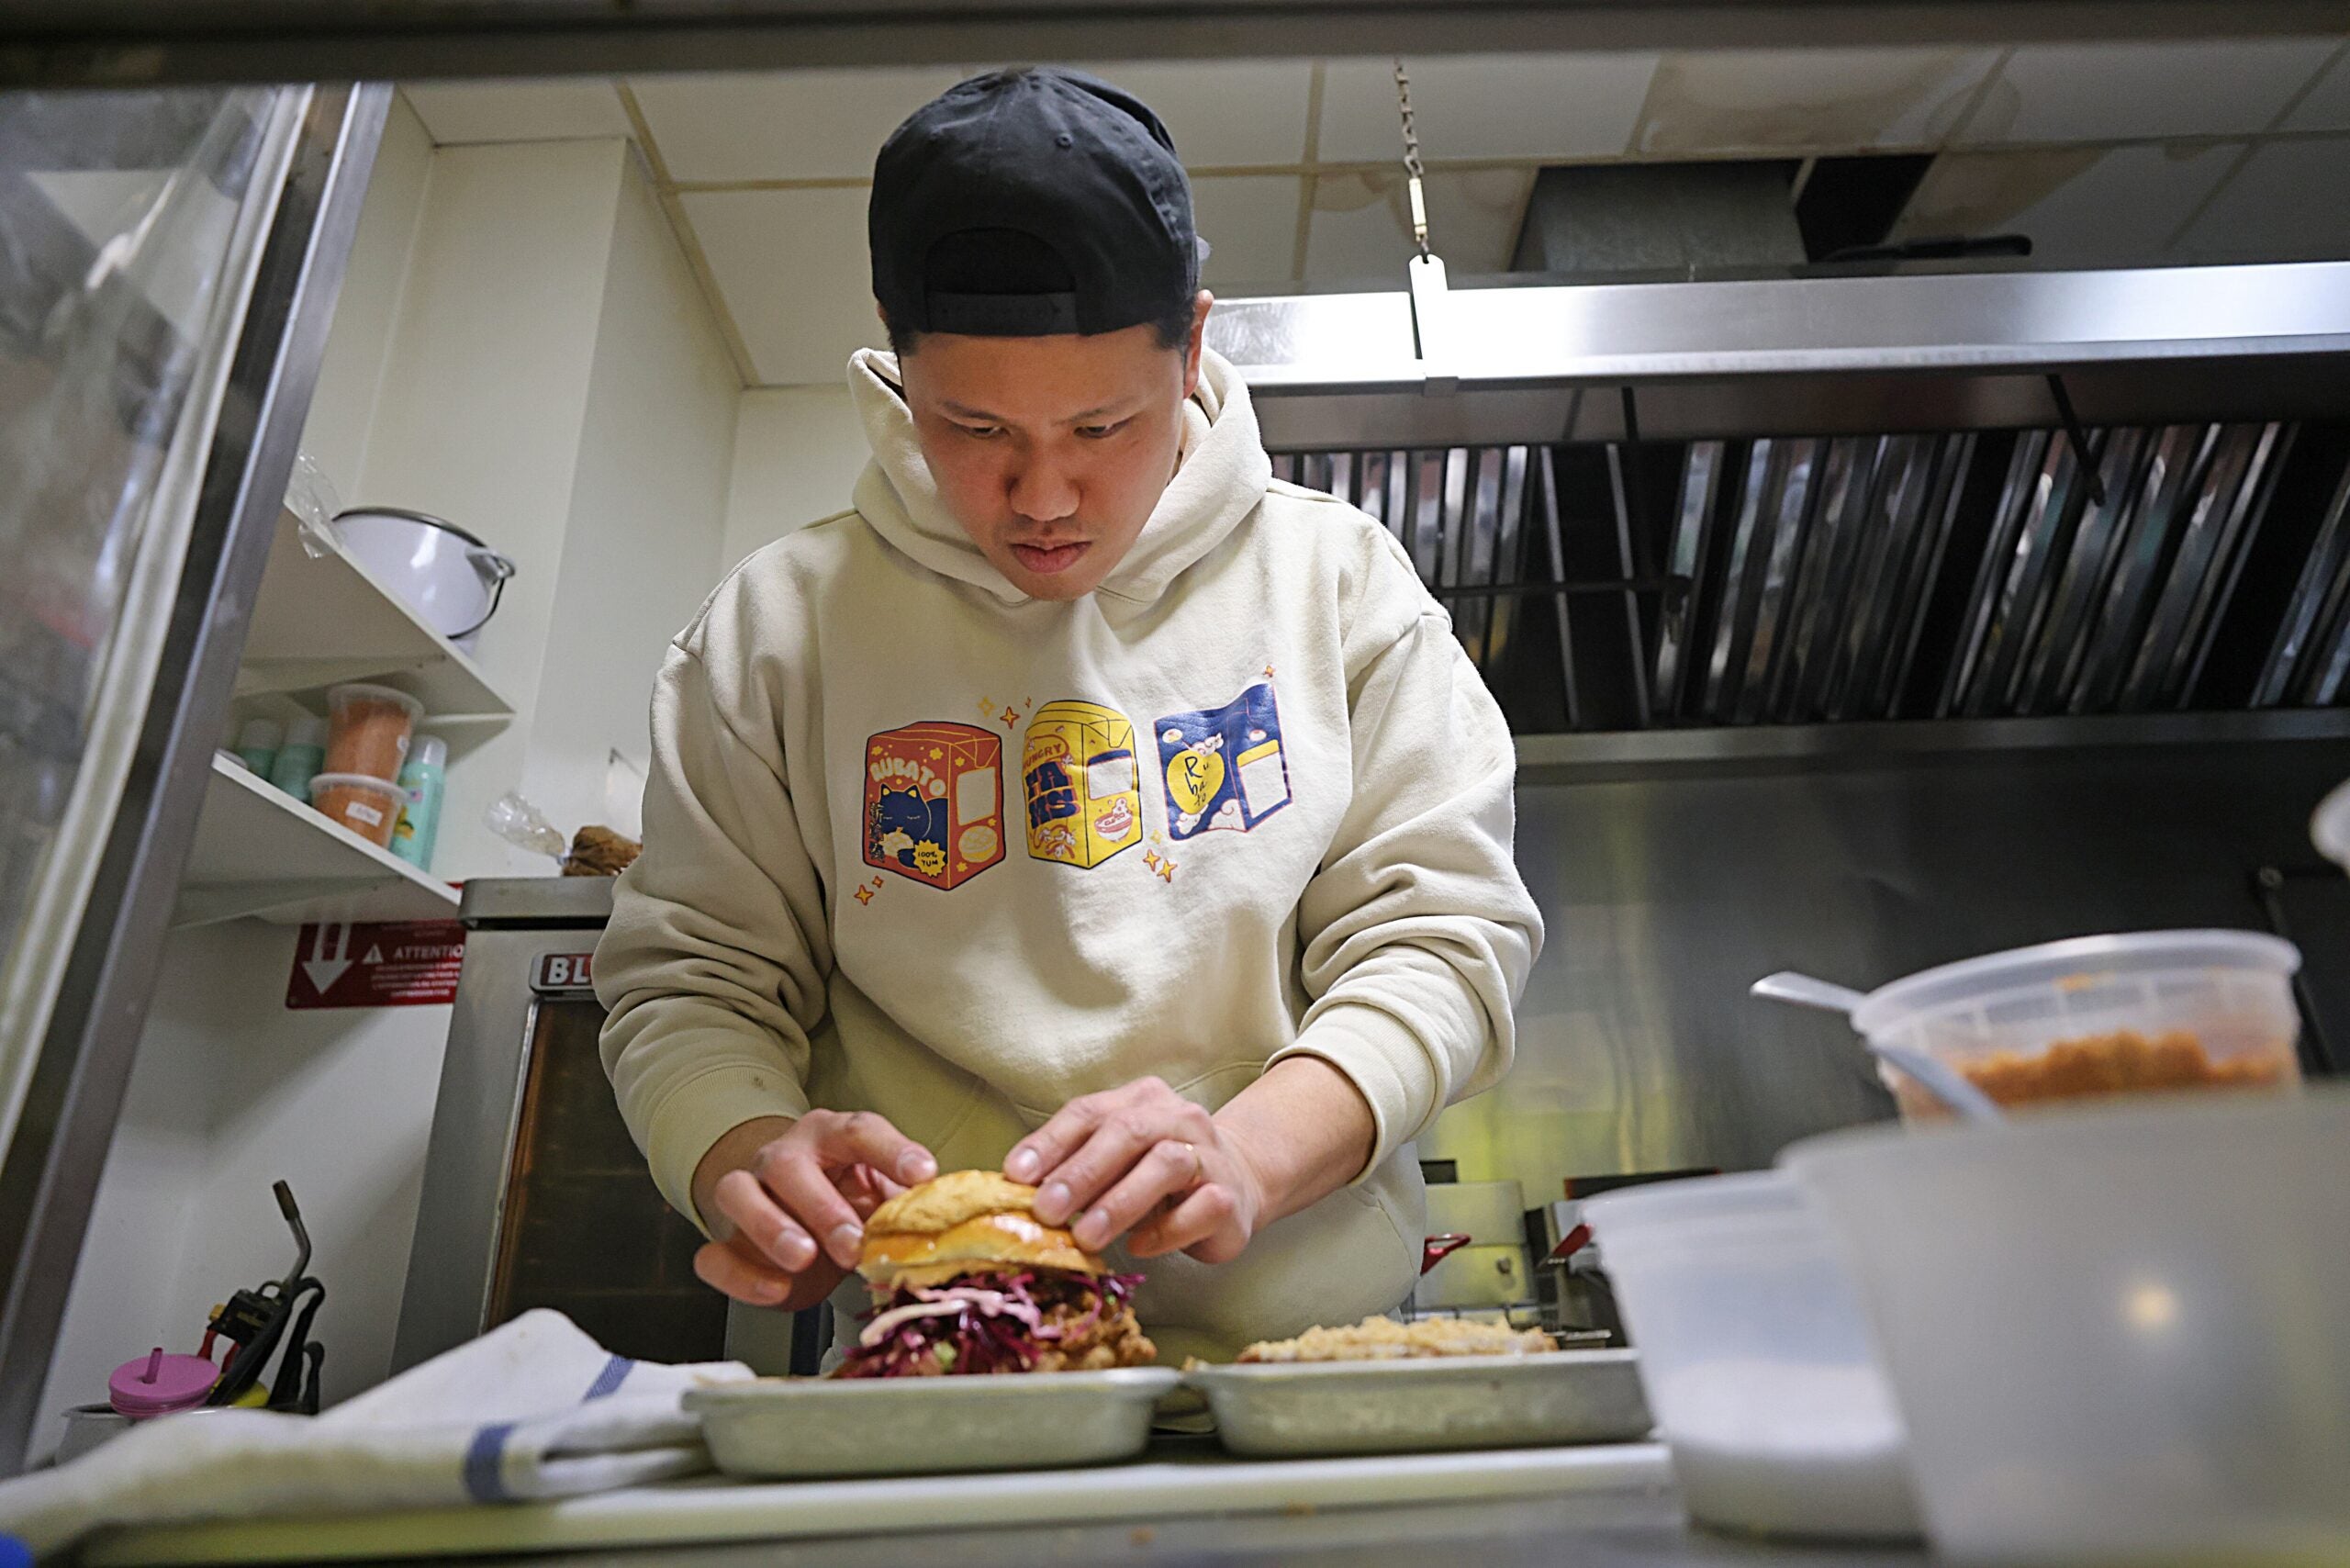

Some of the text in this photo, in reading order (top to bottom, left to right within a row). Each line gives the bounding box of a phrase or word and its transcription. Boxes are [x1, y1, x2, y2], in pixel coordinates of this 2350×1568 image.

[870, 757, 946, 796] RUBATO
[394, 944, 464, 959] ATTENTIO
[547, 957, 590, 983] BL
